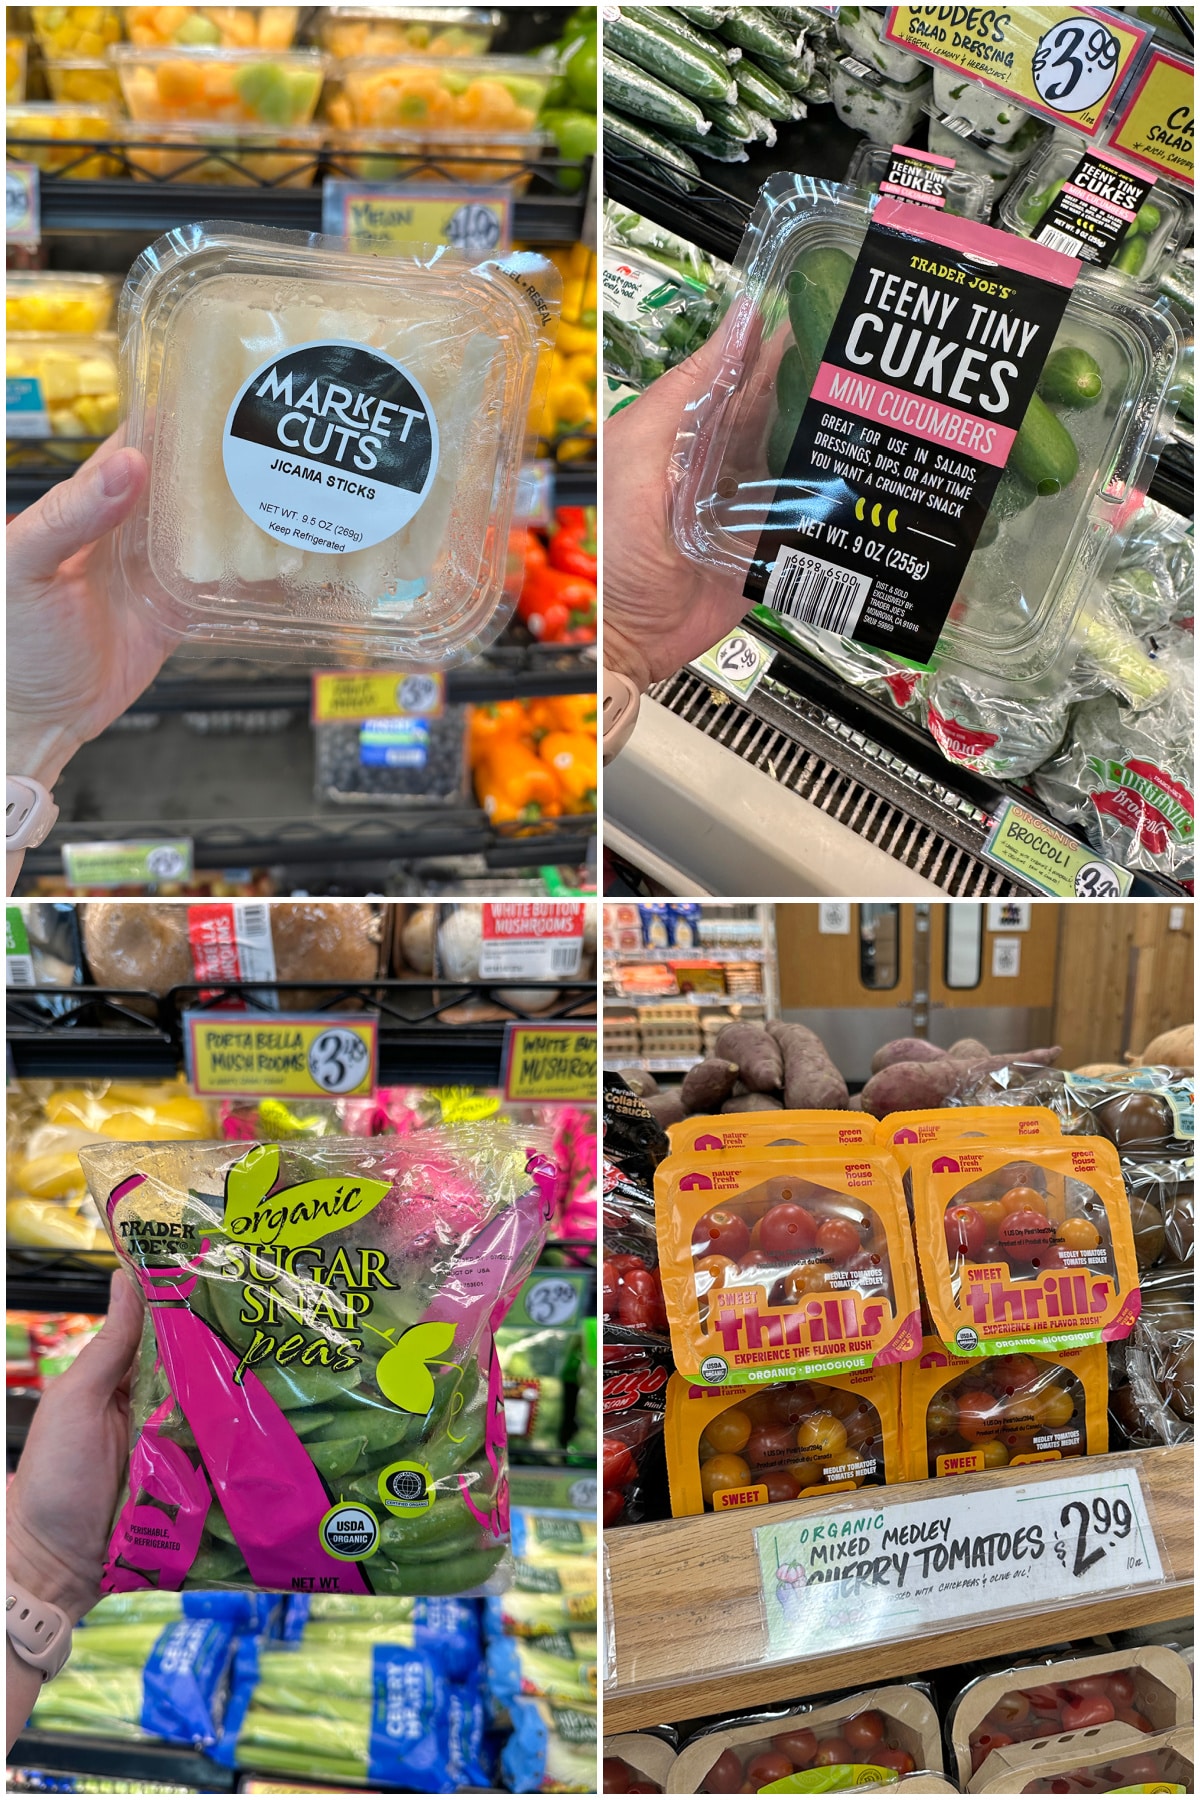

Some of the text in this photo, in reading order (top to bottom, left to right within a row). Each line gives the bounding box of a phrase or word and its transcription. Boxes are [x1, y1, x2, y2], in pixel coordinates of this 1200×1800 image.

[909, 17, 1014, 69] SALAD DRESSING
[1147, 125, 1193, 152] SALAD
[892, 161, 922, 177] TEENY
[924, 170, 948, 184] TINY
[1081, 162, 1143, 198] TEENY TINY
[888, 171, 943, 196] CUKES
[1074, 173, 1137, 210] CUKES
[910, 255, 965, 286] TRADER
[526, 285, 552, 327] RESEAL
[863, 267, 1040, 358] TEENY TINY
[845, 312, 1019, 413] CUKES
[255, 366, 425, 442] MARKET
[828, 372, 997, 454] MINI CUCUMBERS
[277, 411, 382, 471] CUTS
[821, 413, 977, 484] GREAT FOR USE IN SALADS,
[813, 431, 973, 501] DRESSINGS, DIPS, OR ANY TIME
[270, 459, 376, 501] JICAMA STICKS
[810, 450, 964, 518] YOU WANT A CRUNCHY SNACK
[259, 501, 363, 543] NET WT. 9.5 OZ (269g)
[268, 521, 345, 553] Keep Refrigerated
[796, 516, 930, 581] NET WT. 9 OZ (255g)
[894, 587, 909, 599] SOLD
[870, 598, 889, 611] TRADER
[1121, 769, 1192, 828] ORGANIC
[1012, 806, 1079, 851] ORGANIC
[1007, 822, 1070, 868] BROCCOLI
[491, 903, 580, 918] WHITE BUTTON
[494, 917, 575, 936] MUSHROOMS
[616, 1105, 652, 1118] sauces
[1018, 1120, 1039, 1129] green
[1018, 1127, 1040, 1135] house
[723, 1137, 743, 1145] fresh
[838, 1128, 862, 1138] green
[838, 1135, 862, 1143] house
[1071, 1151, 1094, 1159] green
[1071, 1157, 1096, 1165] house
[711, 1169, 739, 1178] nature
[845, 1163, 871, 1173] green
[845, 1170, 873, 1179] house
[960, 1165, 983, 1173] farms
[1074, 1164, 1096, 1173] clean
[711, 1182, 740, 1190] farms
[712, 1176, 736, 1184] fresh
[847, 1178, 873, 1188] clean
[231, 1186, 362, 1240] organic
[119, 1221, 195, 1255] TRADER JOE'S
[1063, 1256, 1108, 1266] TOMATES MEDLEY
[1080, 1249, 1107, 1257] TOMATOES
[220, 1242, 400, 1290] SUGAR
[824, 1269, 883, 1281] MEDLEY TOMATOES
[967, 1268, 1001, 1281] SWEET
[718, 1291, 757, 1306] SWEET
[966, 1276, 1110, 1324] thrills
[239, 1284, 374, 1333] SNAP
[715, 1299, 884, 1352] thrills
[983, 1316, 1100, 1335] EXPERIENCE THE FLAVOR RUSH
[996, 1331, 1096, 1348] ORGANIC BIOLOGIQUE
[232, 1328, 362, 1387] peas
[735, 1341, 873, 1365] EXPERIENCE THE FLAVOR RUSH
[1058, 1349, 1080, 1358] clean
[706, 1362, 722, 1370] USDA
[748, 1358, 866, 1382] ORGANIC BIOLOGIQUE
[948, 1358, 969, 1366] farms
[850, 1375, 874, 1385] clean
[721, 1388, 747, 1397] farms
[1033, 1430, 1080, 1444] MEDLEY TOMATOES
[1036, 1438, 1080, 1450] TOMATES MEDLEY
[823, 1459, 877, 1475] MEDLEY TOMATOES
[944, 1456, 977, 1470] SWEET
[827, 1466, 877, 1482] TOMATES MEDLEY
[722, 1491, 759, 1506] SWEET
[130, 1524, 169, 1539] PERISHABLE,
[336, 1520, 365, 1531] USDA
[800, 1514, 884, 1544] ORGANIC
[134, 1537, 180, 1551] REFRIGERATED
[333, 1534, 368, 1544] ORGANIC
[810, 1517, 951, 1566] MIXED MEDLEY
[914, 1524, 1045, 1579] TOMATOES
[291, 1577, 315, 1589] NET
[915, 1566, 1031, 1598] WITH CHICKPEAS OLIVE OIL!
